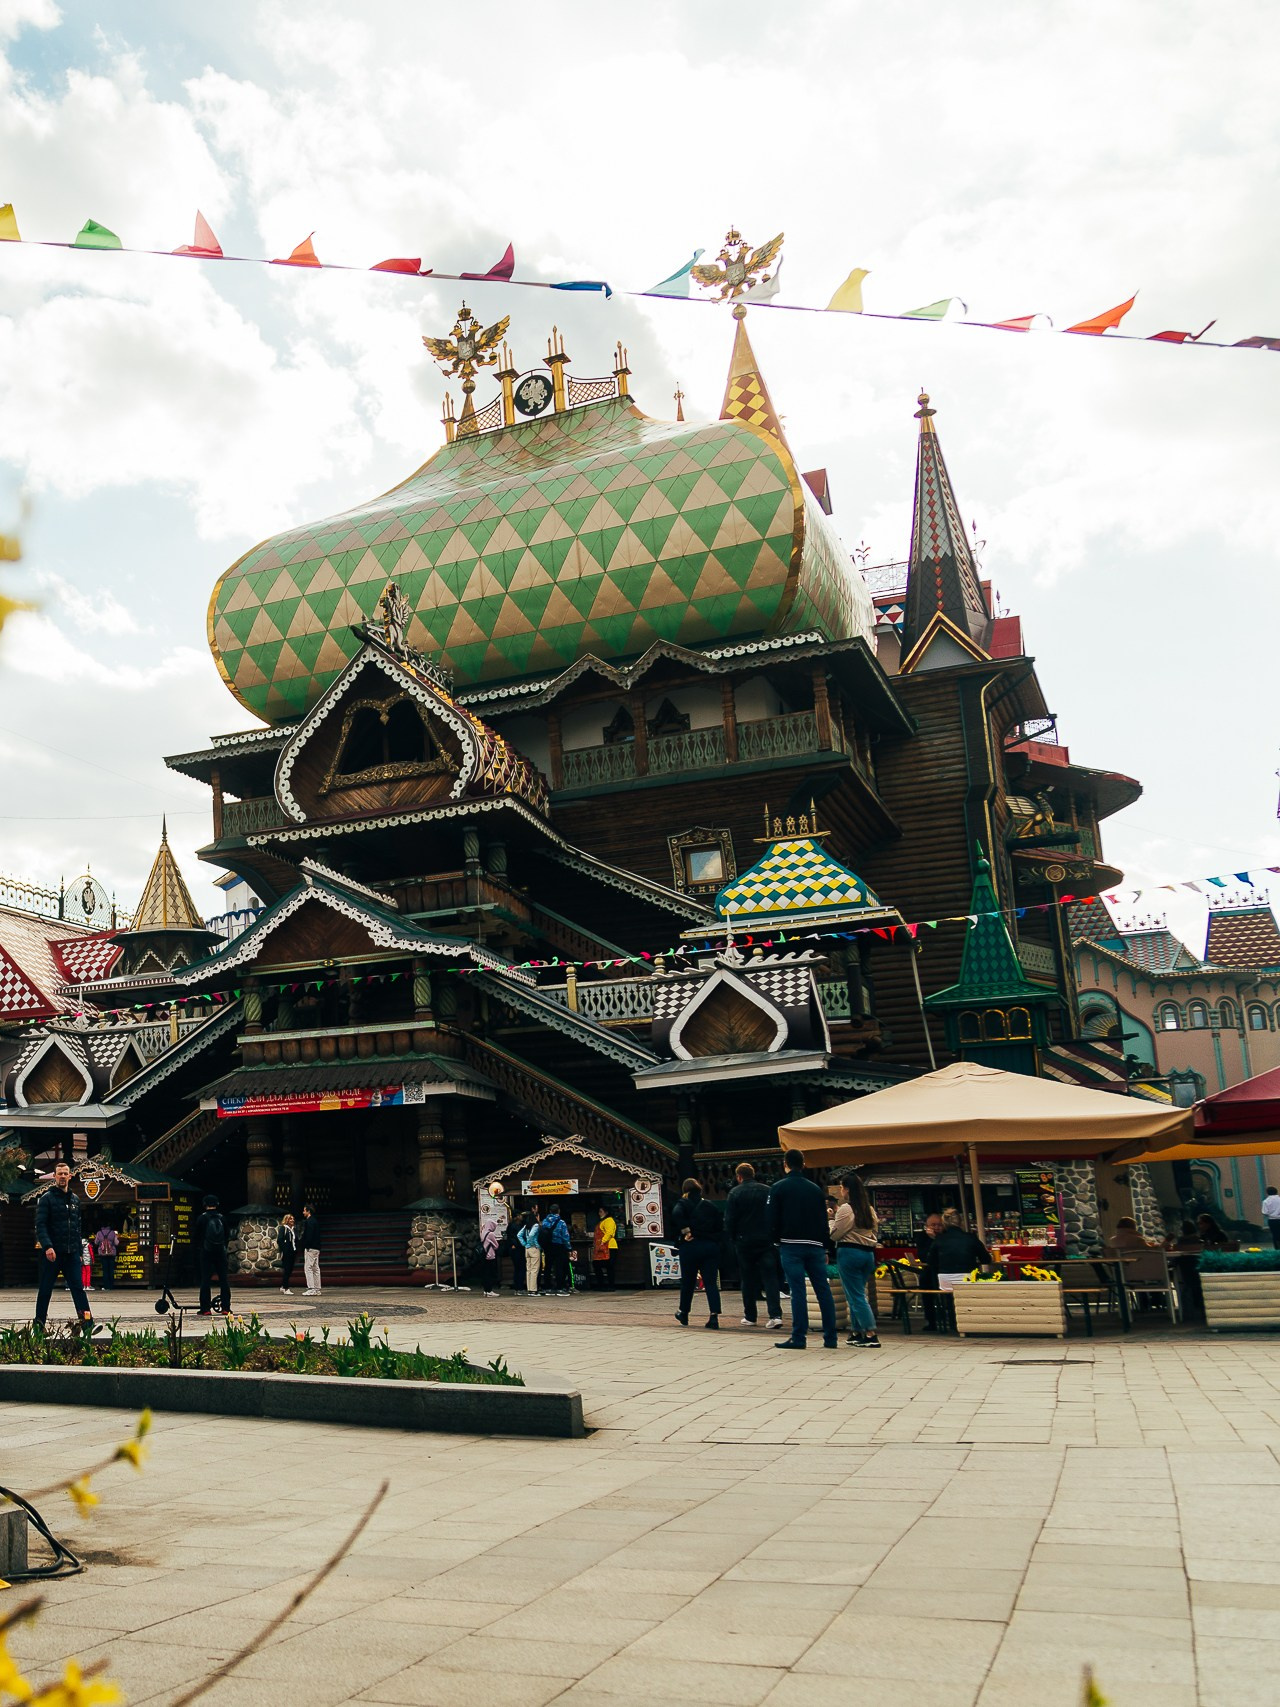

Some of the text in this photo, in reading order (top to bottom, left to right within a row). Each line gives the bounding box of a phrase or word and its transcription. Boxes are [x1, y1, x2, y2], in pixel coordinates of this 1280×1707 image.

[222, 1095, 265, 1105] СПЕКТАКЛИ
[266, 1094, 283, 1103] ДЛЯ
[284, 1092, 309, 1102] ДЕТЕЙ
[115, 1255, 144, 1263] ДОВУХА
